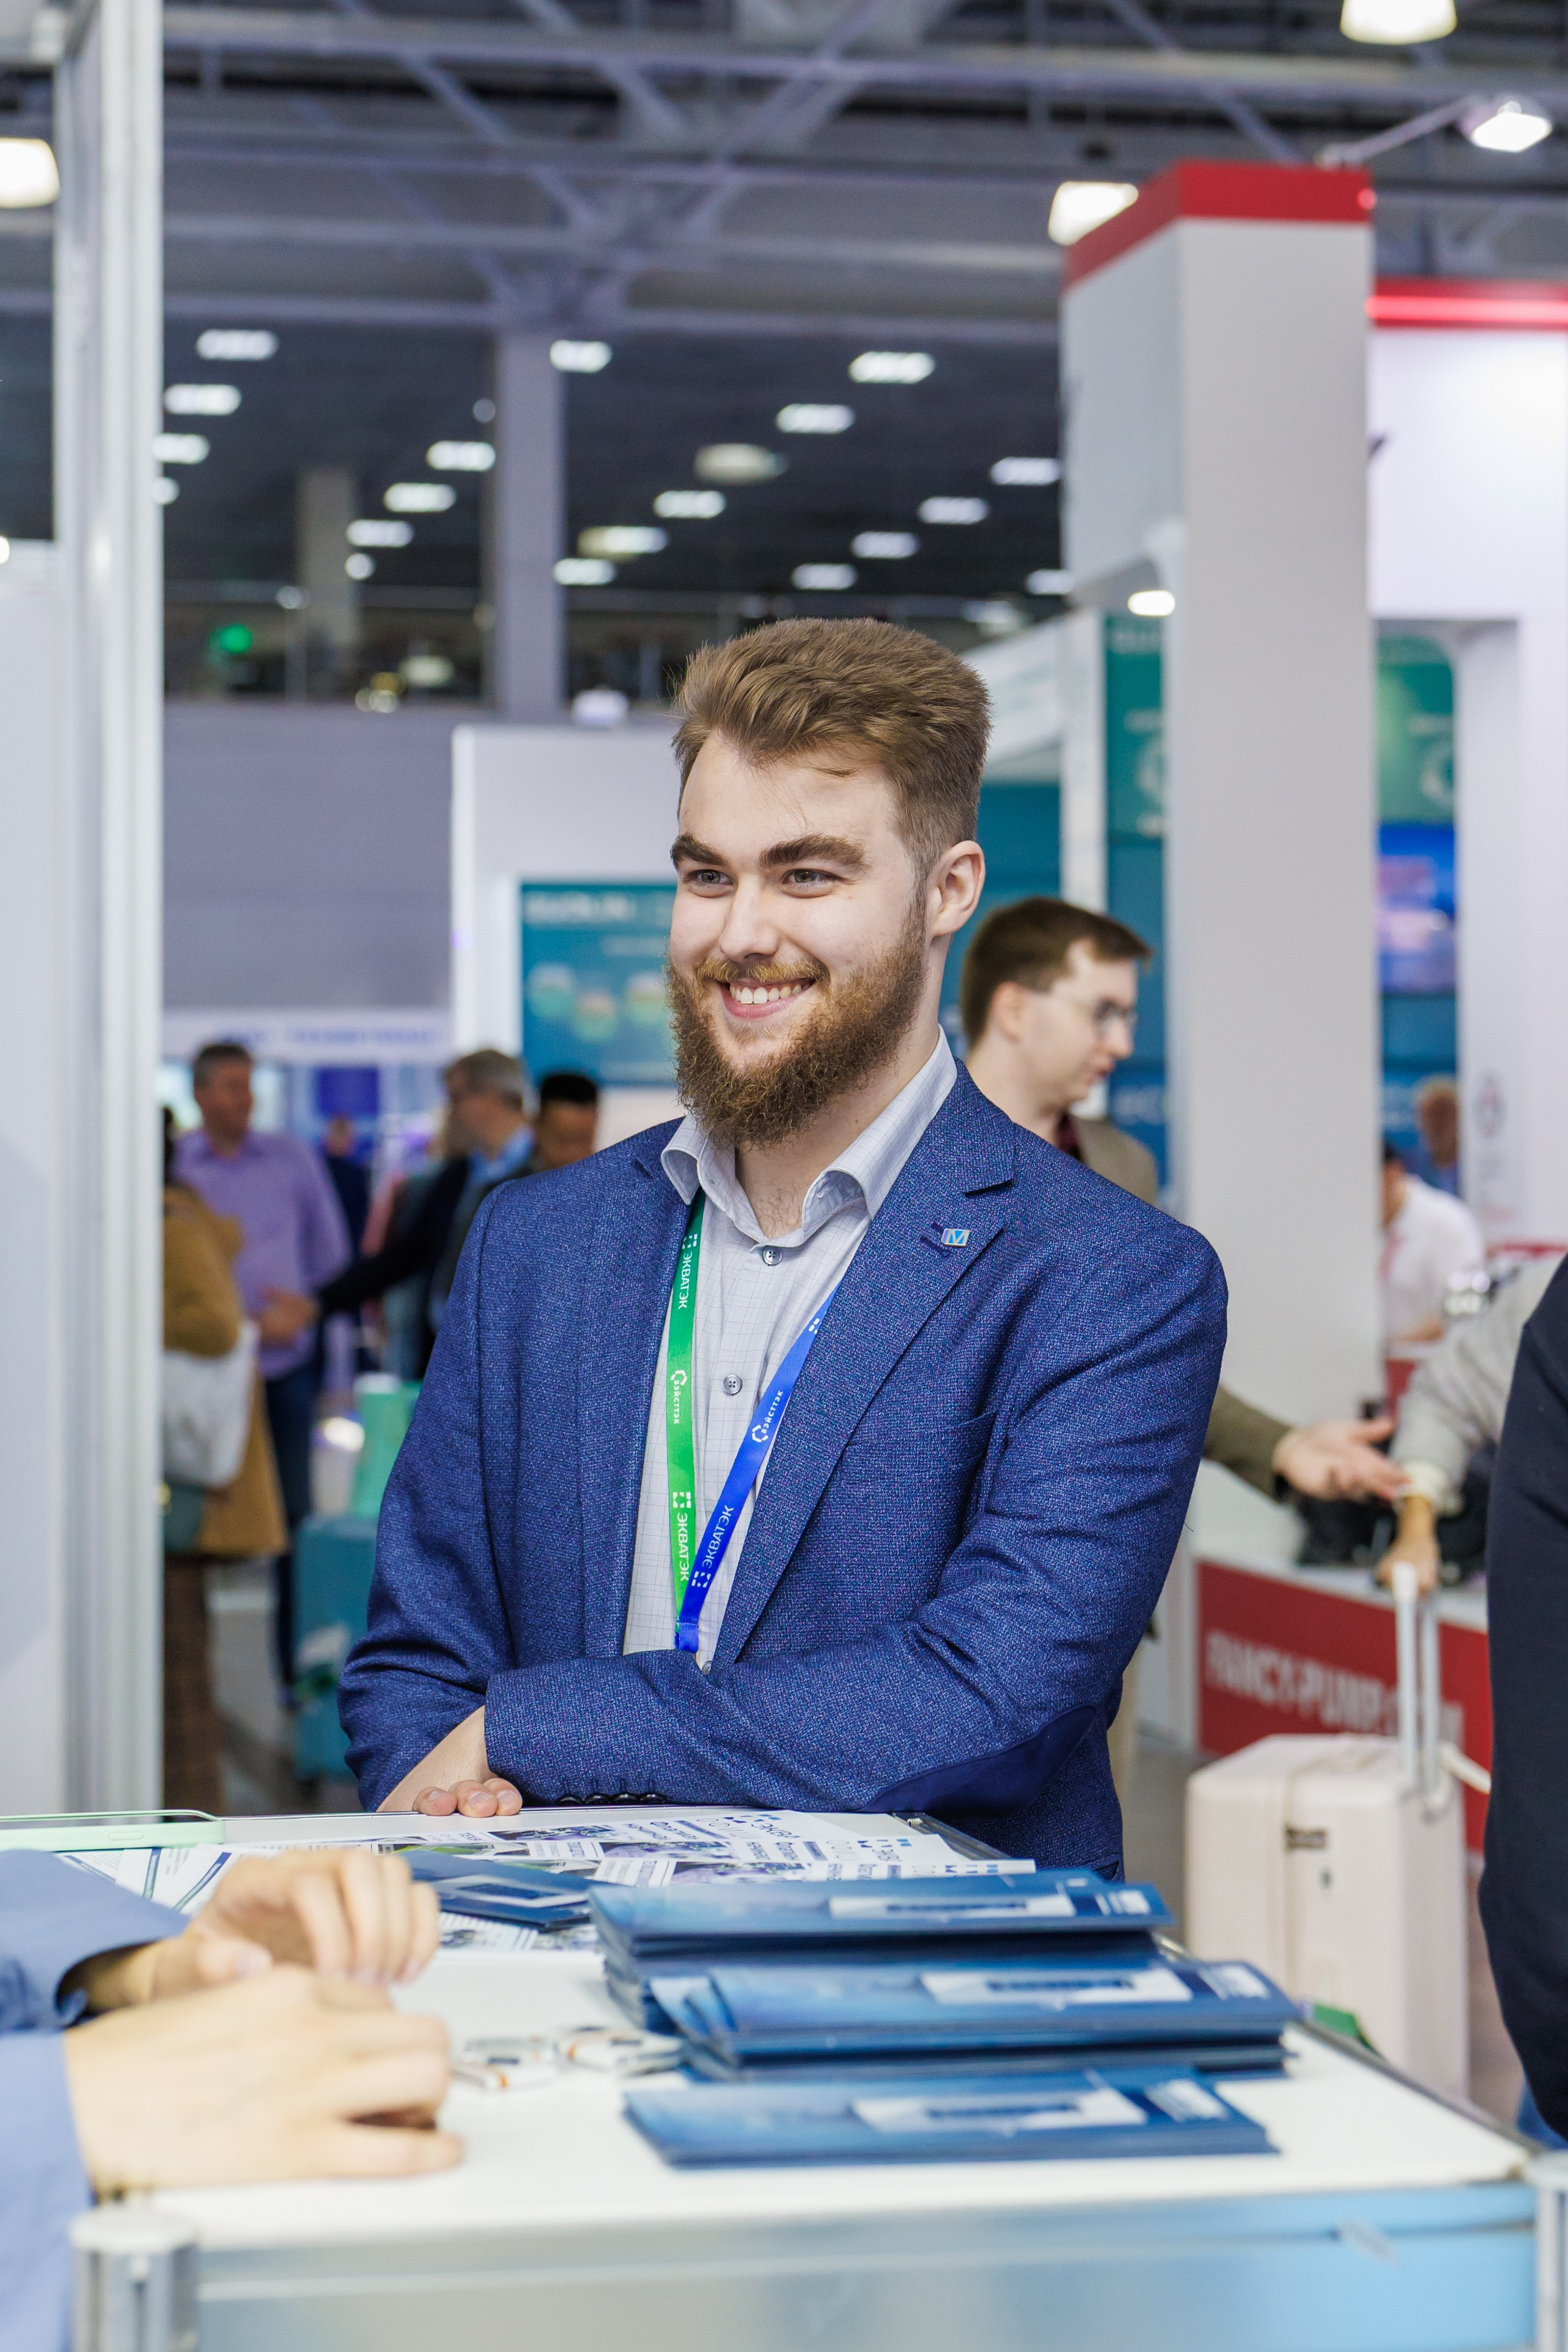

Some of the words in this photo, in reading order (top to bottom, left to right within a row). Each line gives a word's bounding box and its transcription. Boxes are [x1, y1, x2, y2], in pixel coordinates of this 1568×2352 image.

[678, 1251, 693, 1310] ЭКВАТЭК
[761, 1390, 783, 1434] ВЭЙСТТЭК
[677, 1512, 690, 1581] ЭКВАТЭК
[702, 1505, 734, 1569] ЭКВАТЭК
